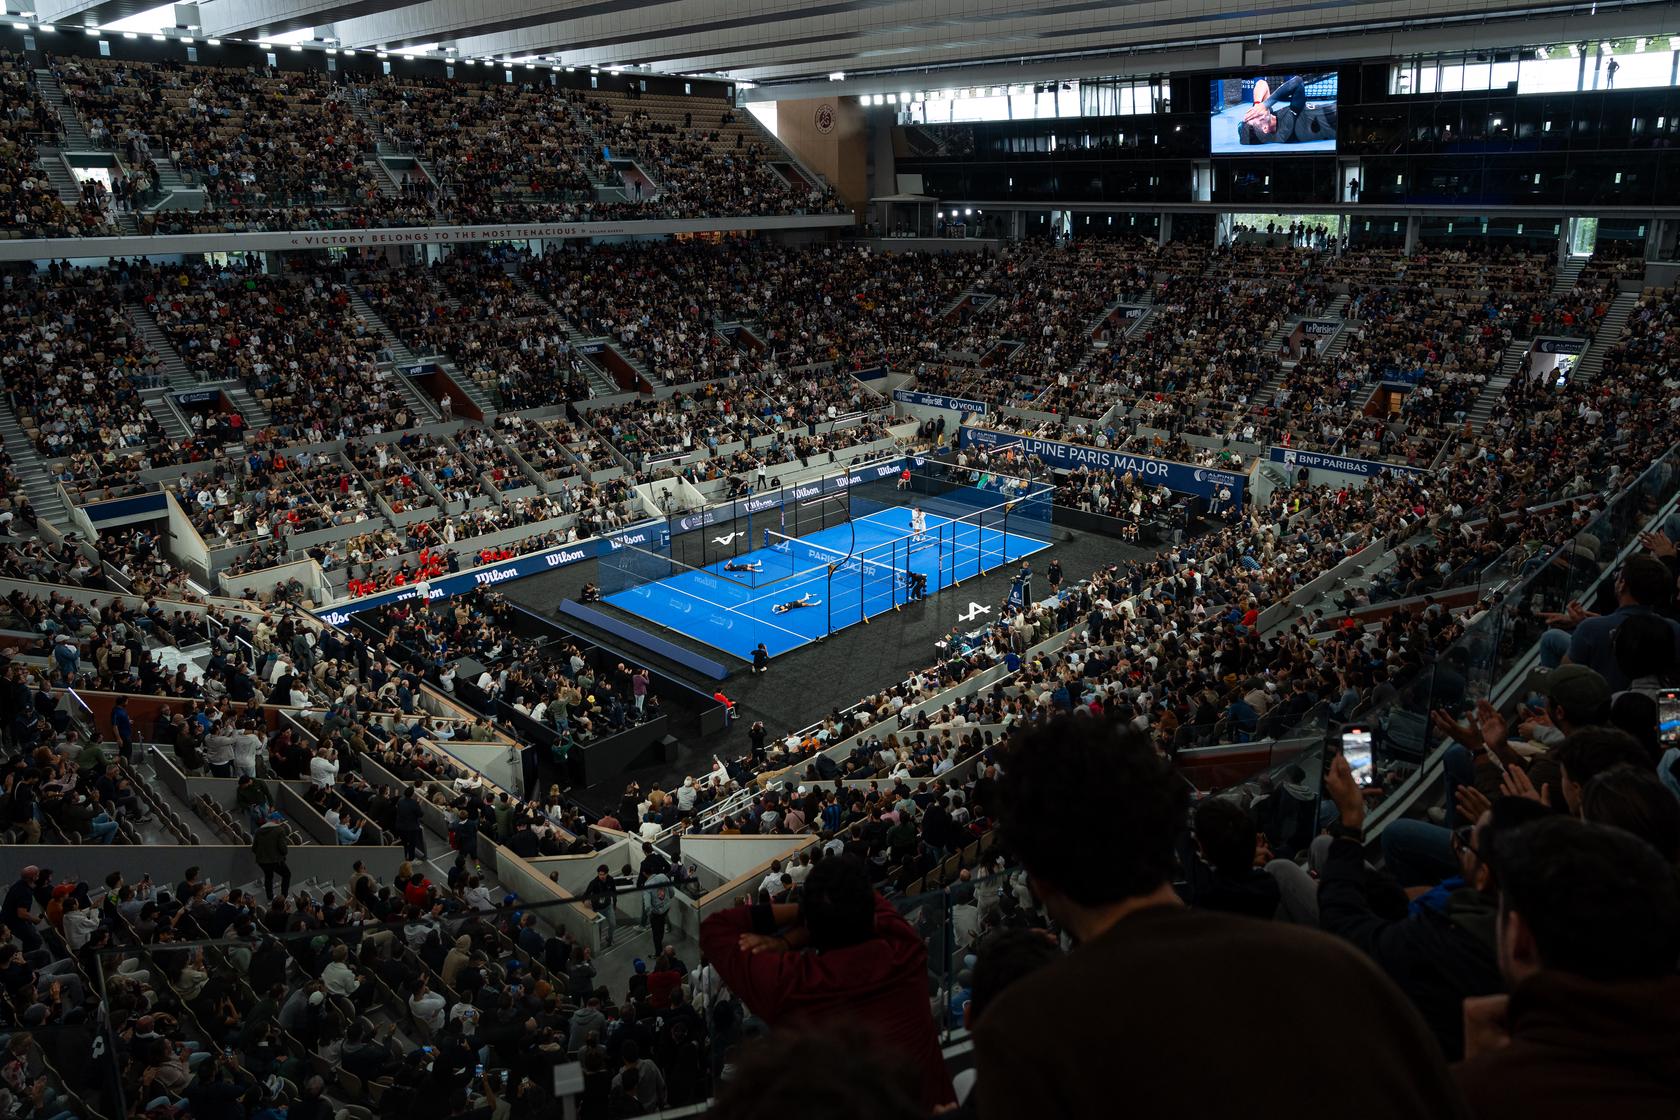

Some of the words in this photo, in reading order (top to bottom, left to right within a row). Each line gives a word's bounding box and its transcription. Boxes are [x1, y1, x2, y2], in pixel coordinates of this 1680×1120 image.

[305, 235, 364, 244] VICTORY
[371, 233, 428, 242] BELONGS
[455, 231, 476, 239] THE
[482, 229, 511, 238] MOST
[516, 227, 576, 236] TENACIOUS
[1069, 447, 1110, 466] PARIS
[1114, 455, 1168, 477] MAJOR
[1299, 455, 1321, 465] BNP
[1323, 459, 1368, 473] PARIBAS
[877, 465, 901, 477] Wilson
[792, 486, 819, 500] Wilson
[609, 533, 646, 550] Wlson
[545, 550, 586, 567] Wilson
[808, 549, 837, 563] PARIS
[475, 568, 519, 585] Wilson
